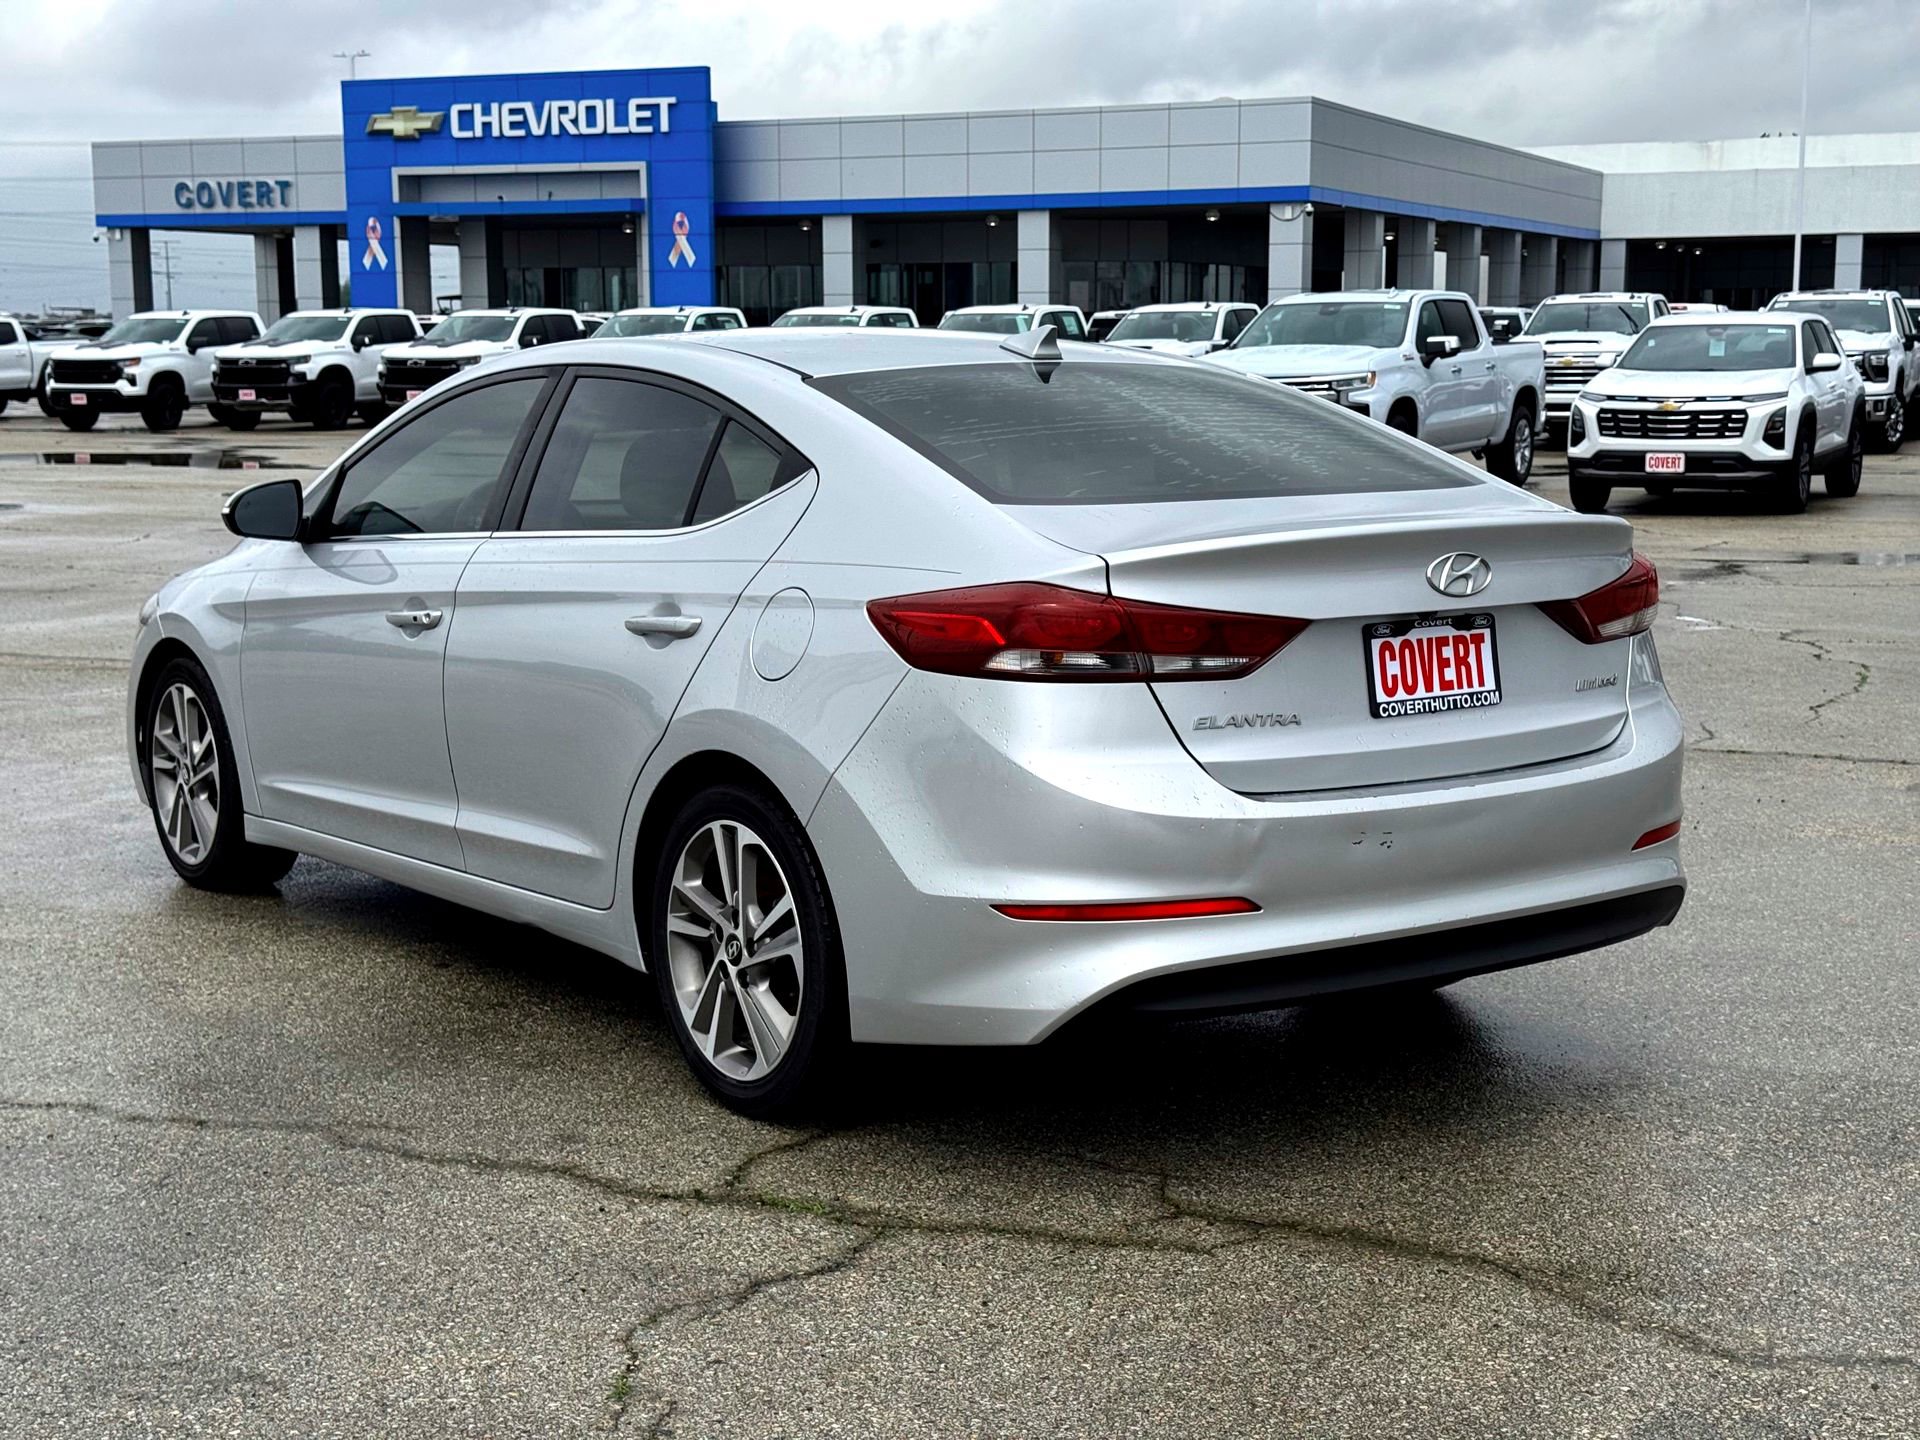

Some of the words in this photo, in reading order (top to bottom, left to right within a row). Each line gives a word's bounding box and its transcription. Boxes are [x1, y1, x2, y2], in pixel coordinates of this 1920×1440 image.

[450, 96, 678, 138] CHEVROLET
[174, 180, 293, 209] COVERT
[1648, 456, 1682, 469] COVERT
[1414, 617, 1453, 628] Covert
[1378, 632, 1486, 698] COVERT
[1379, 691, 1500, 717] COVERTHUTTO.COM
[1192, 712, 1302, 730] ELANTRA
